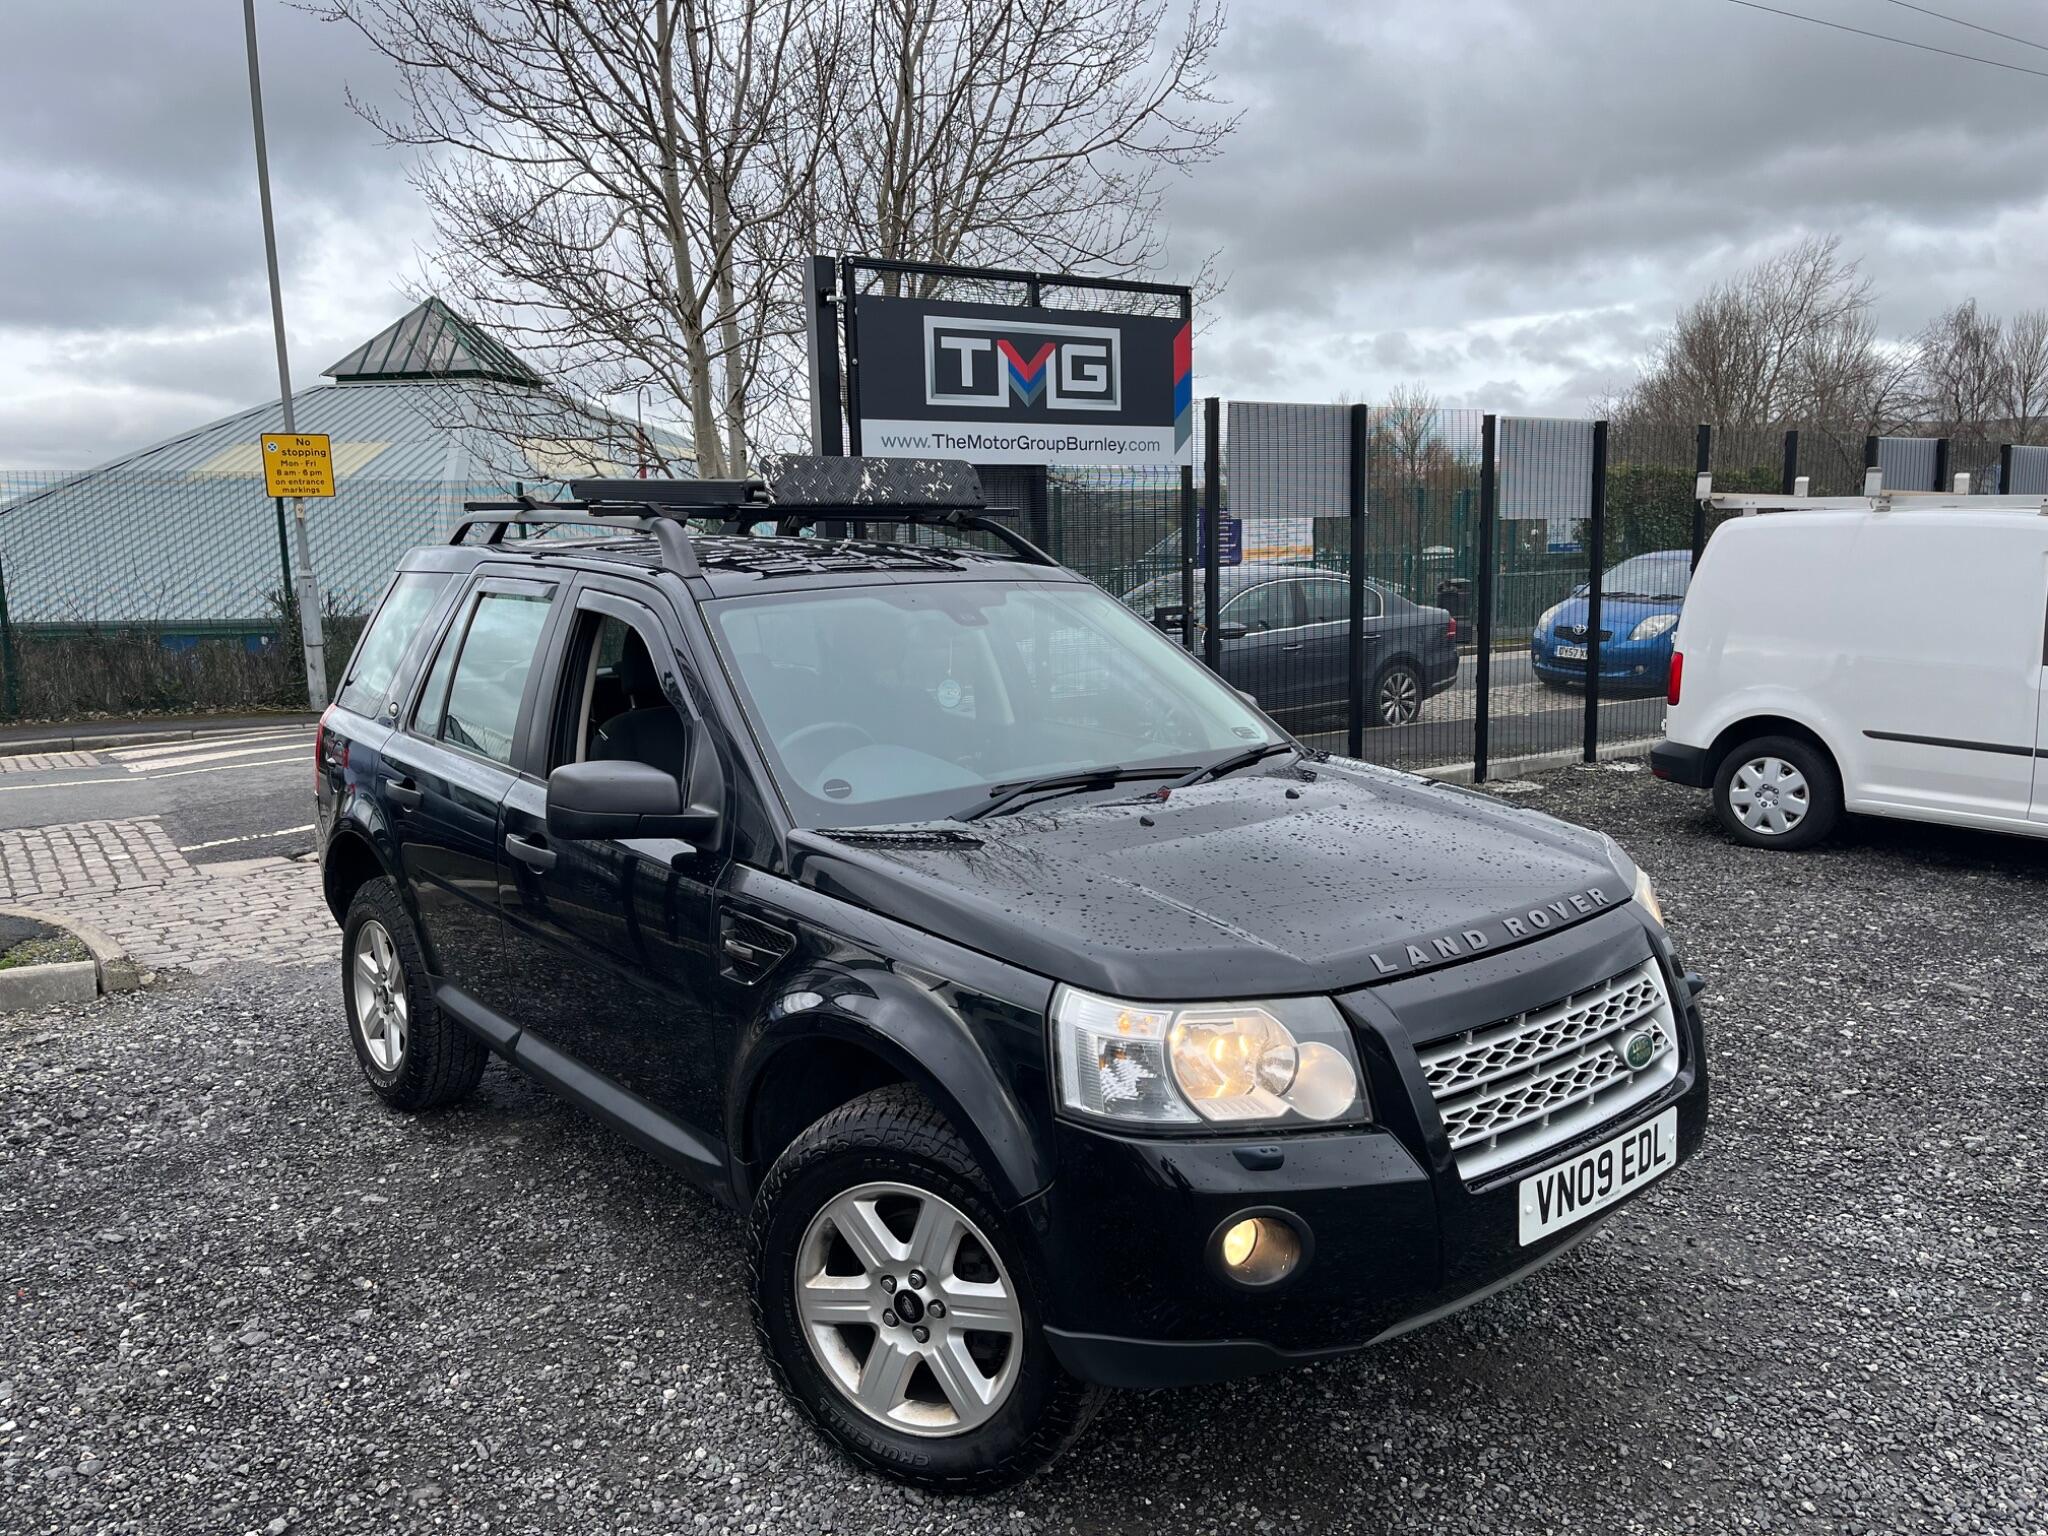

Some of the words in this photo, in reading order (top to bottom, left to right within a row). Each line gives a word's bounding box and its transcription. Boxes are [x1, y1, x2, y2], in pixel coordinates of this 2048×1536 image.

[940, 335, 1108, 408] TMG
[281, 448, 327, 457] stopping
[296, 438, 311, 446] No
[881, 432, 1161, 454] www.TheMotorGroupBurnley.com
[1368, 929, 1490, 974] LAND
[1502, 887, 1609, 938] ROVER
[1536, 1149, 1613, 1226] VN09
[1621, 1123, 1666, 1186] EDL
